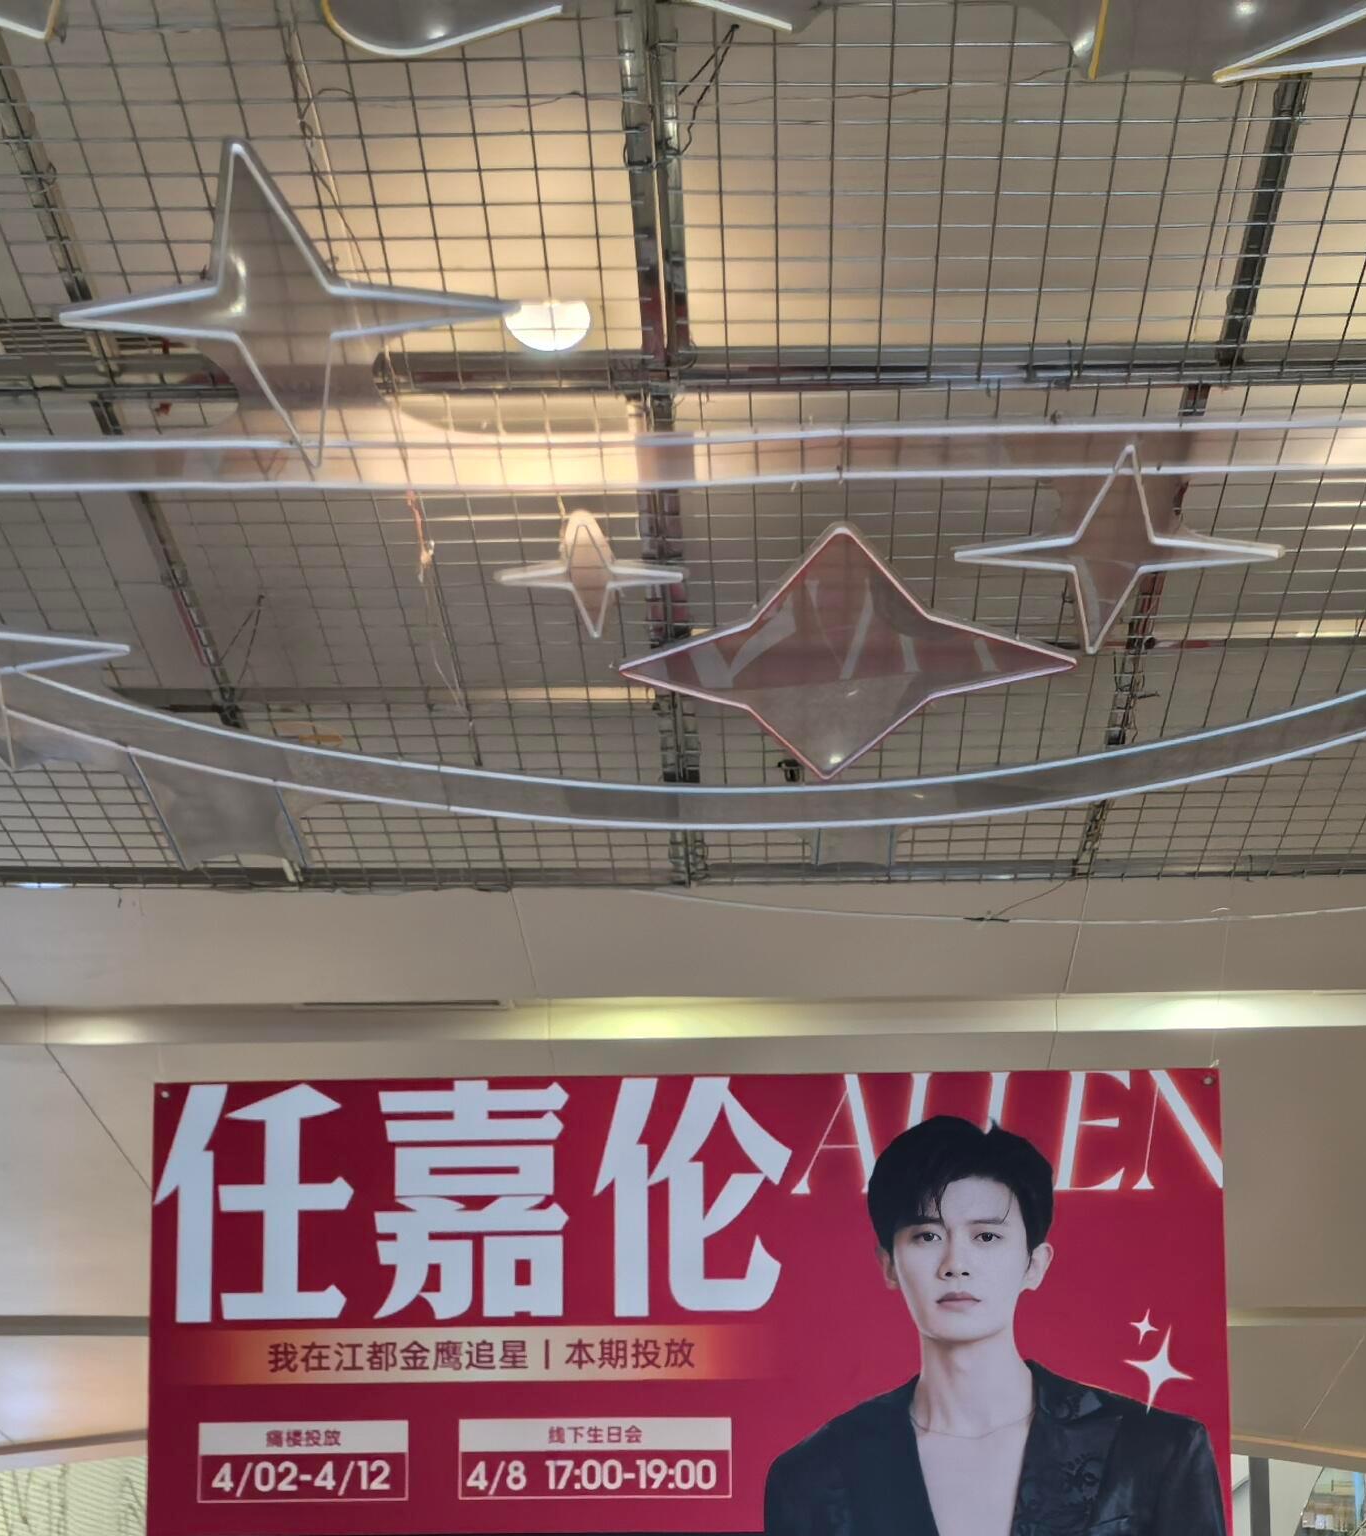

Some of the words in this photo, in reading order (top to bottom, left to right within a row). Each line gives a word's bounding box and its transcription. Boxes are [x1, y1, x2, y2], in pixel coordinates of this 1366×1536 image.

[154, 1076, 793, 1323] 任嘉伦
[547, 1425, 643, 1445] 线下生日会
[211, 1459, 391, 1498] 4/02-4/12
[466, 1460, 527, 1495] 4/8
[545, 1457, 718, 1492] 17:00-19:00
